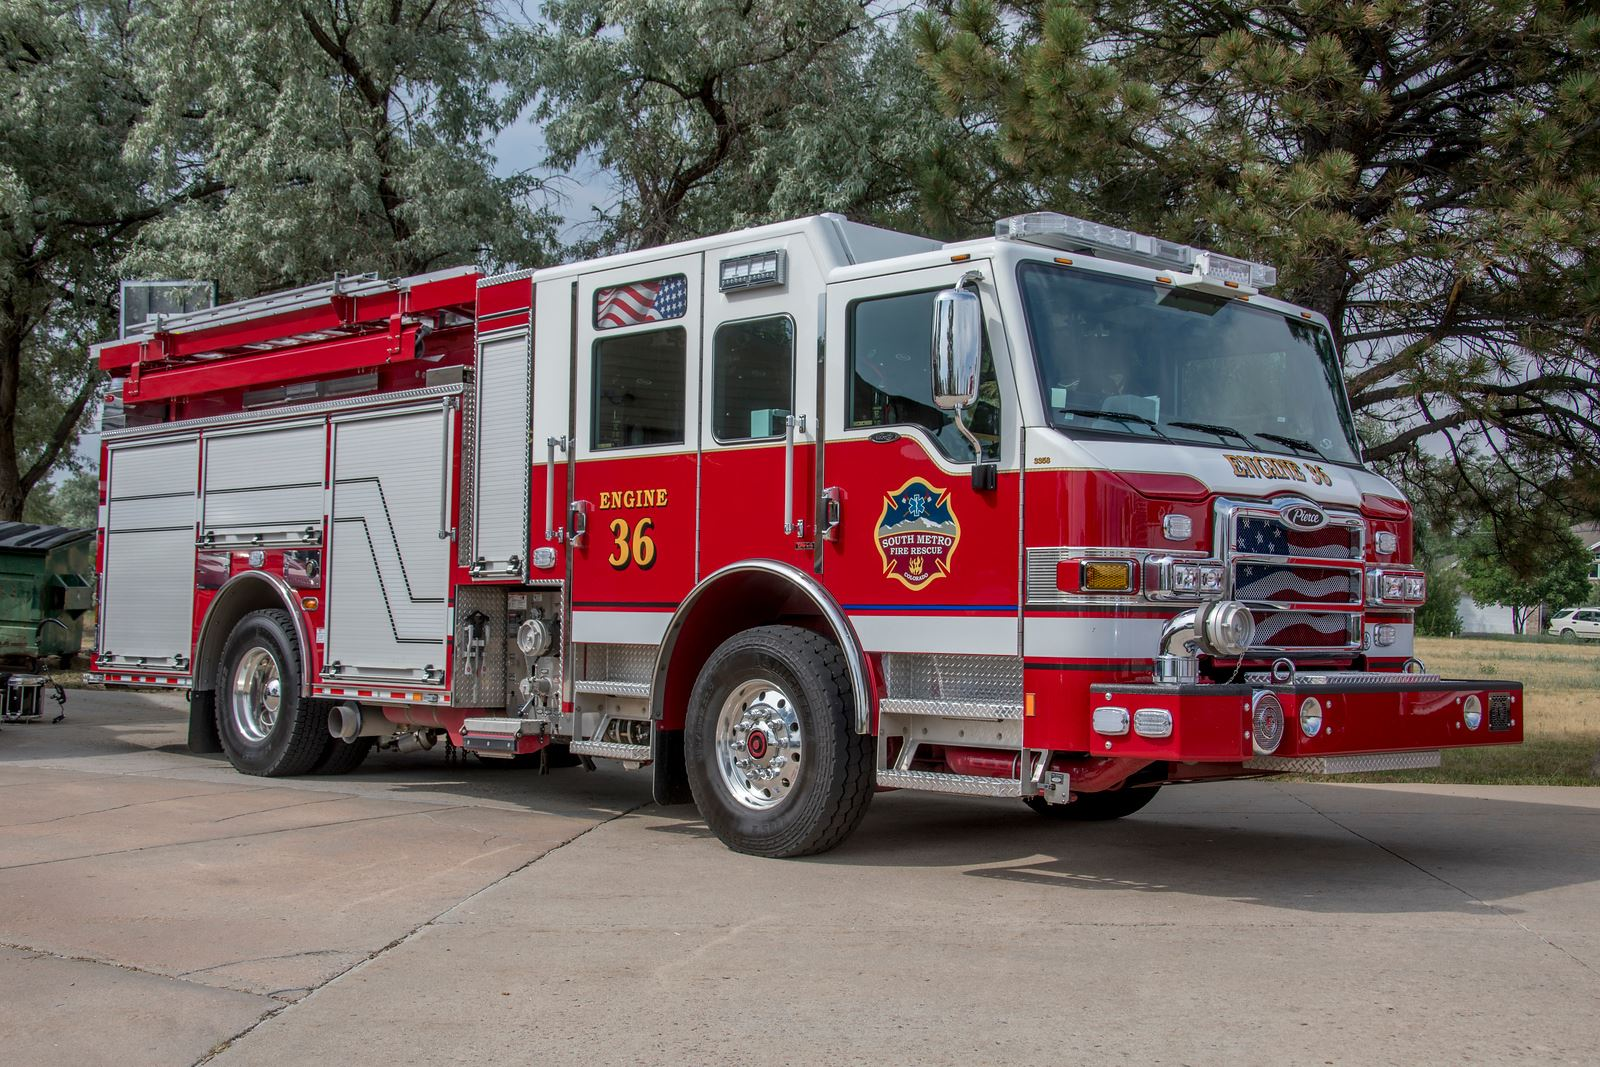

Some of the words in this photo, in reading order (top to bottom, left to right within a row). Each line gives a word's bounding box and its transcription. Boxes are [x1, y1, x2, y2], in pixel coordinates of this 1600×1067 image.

[1223, 454, 1307, 482] ENGINE
[1303, 463, 1333, 487] 36
[599, 488, 668, 510] ENGINE
[1293, 508, 1320, 523] Pierce
[608, 517, 657, 571] 36
[882, 534, 915, 548] SOUTH
[916, 535, 952, 547] METRO
[890, 547, 909, 555] FIRE
[910, 546, 943, 555] RESCUE
[903, 572, 929, 582] COLORADO
